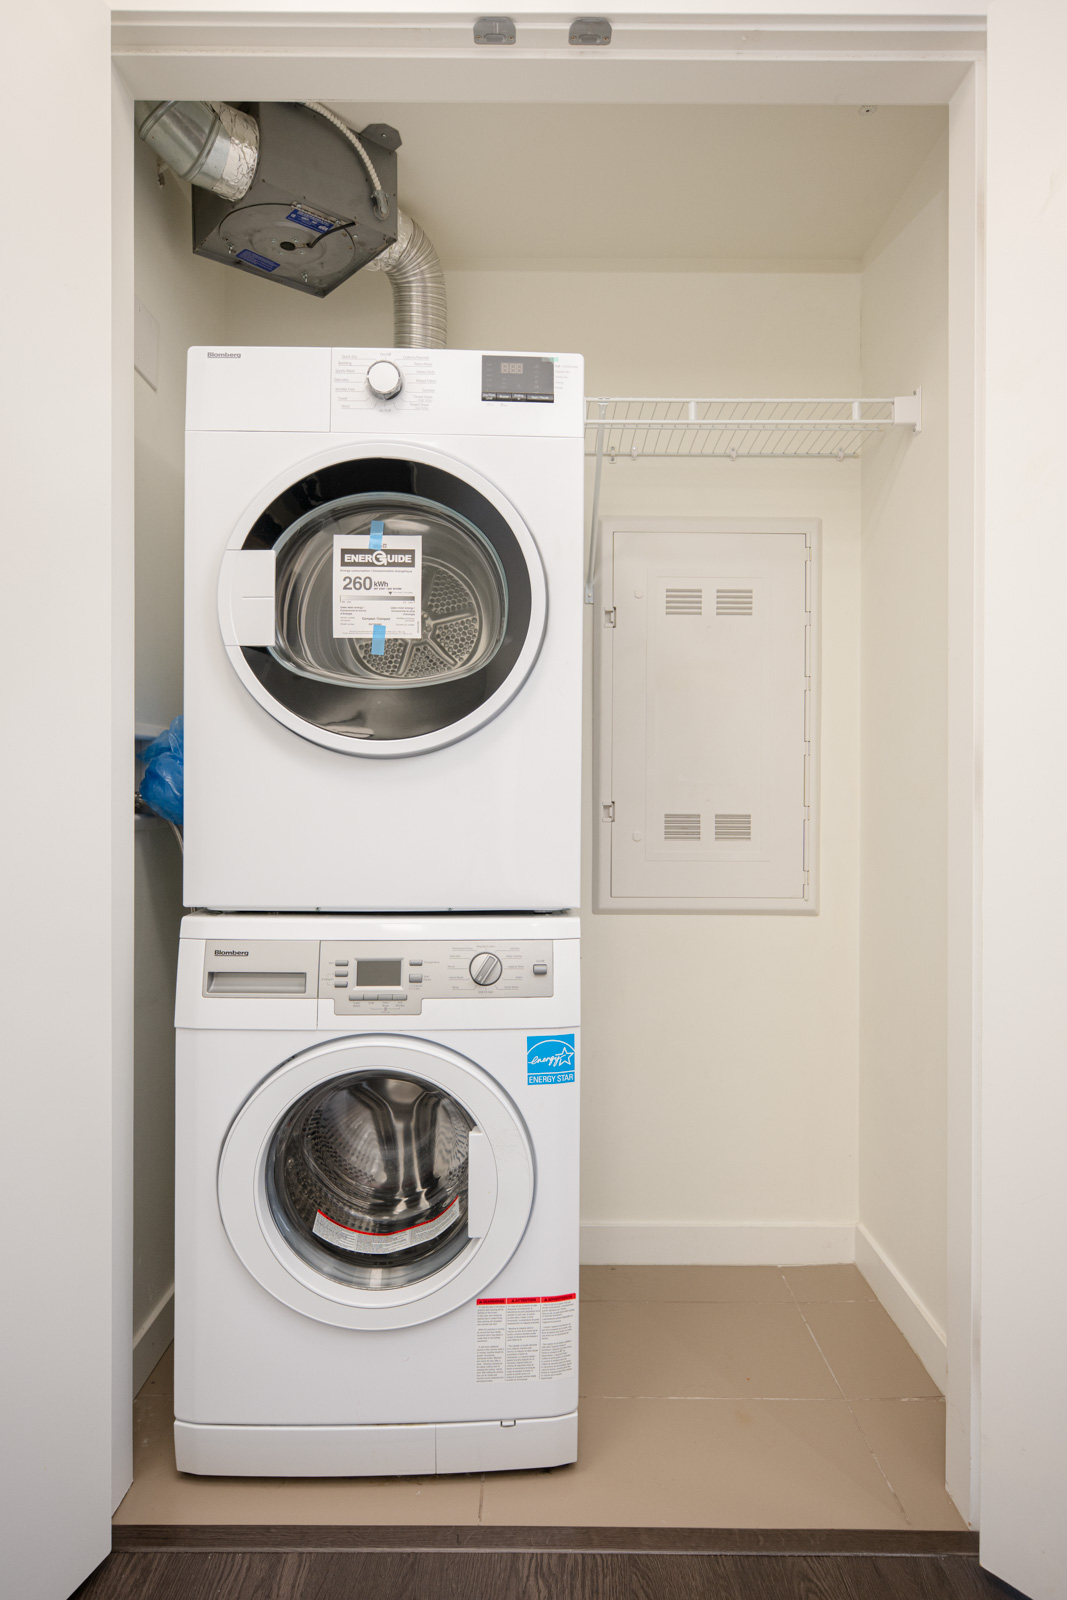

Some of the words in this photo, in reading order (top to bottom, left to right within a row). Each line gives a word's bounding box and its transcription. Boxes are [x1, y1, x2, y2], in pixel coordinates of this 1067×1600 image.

[344, 550, 412, 566] ENERGUIDE
[342, 576, 372, 590] 260
[529, 1075, 556, 1084] ENERGY
[557, 1073, 574, 1082] STAR
